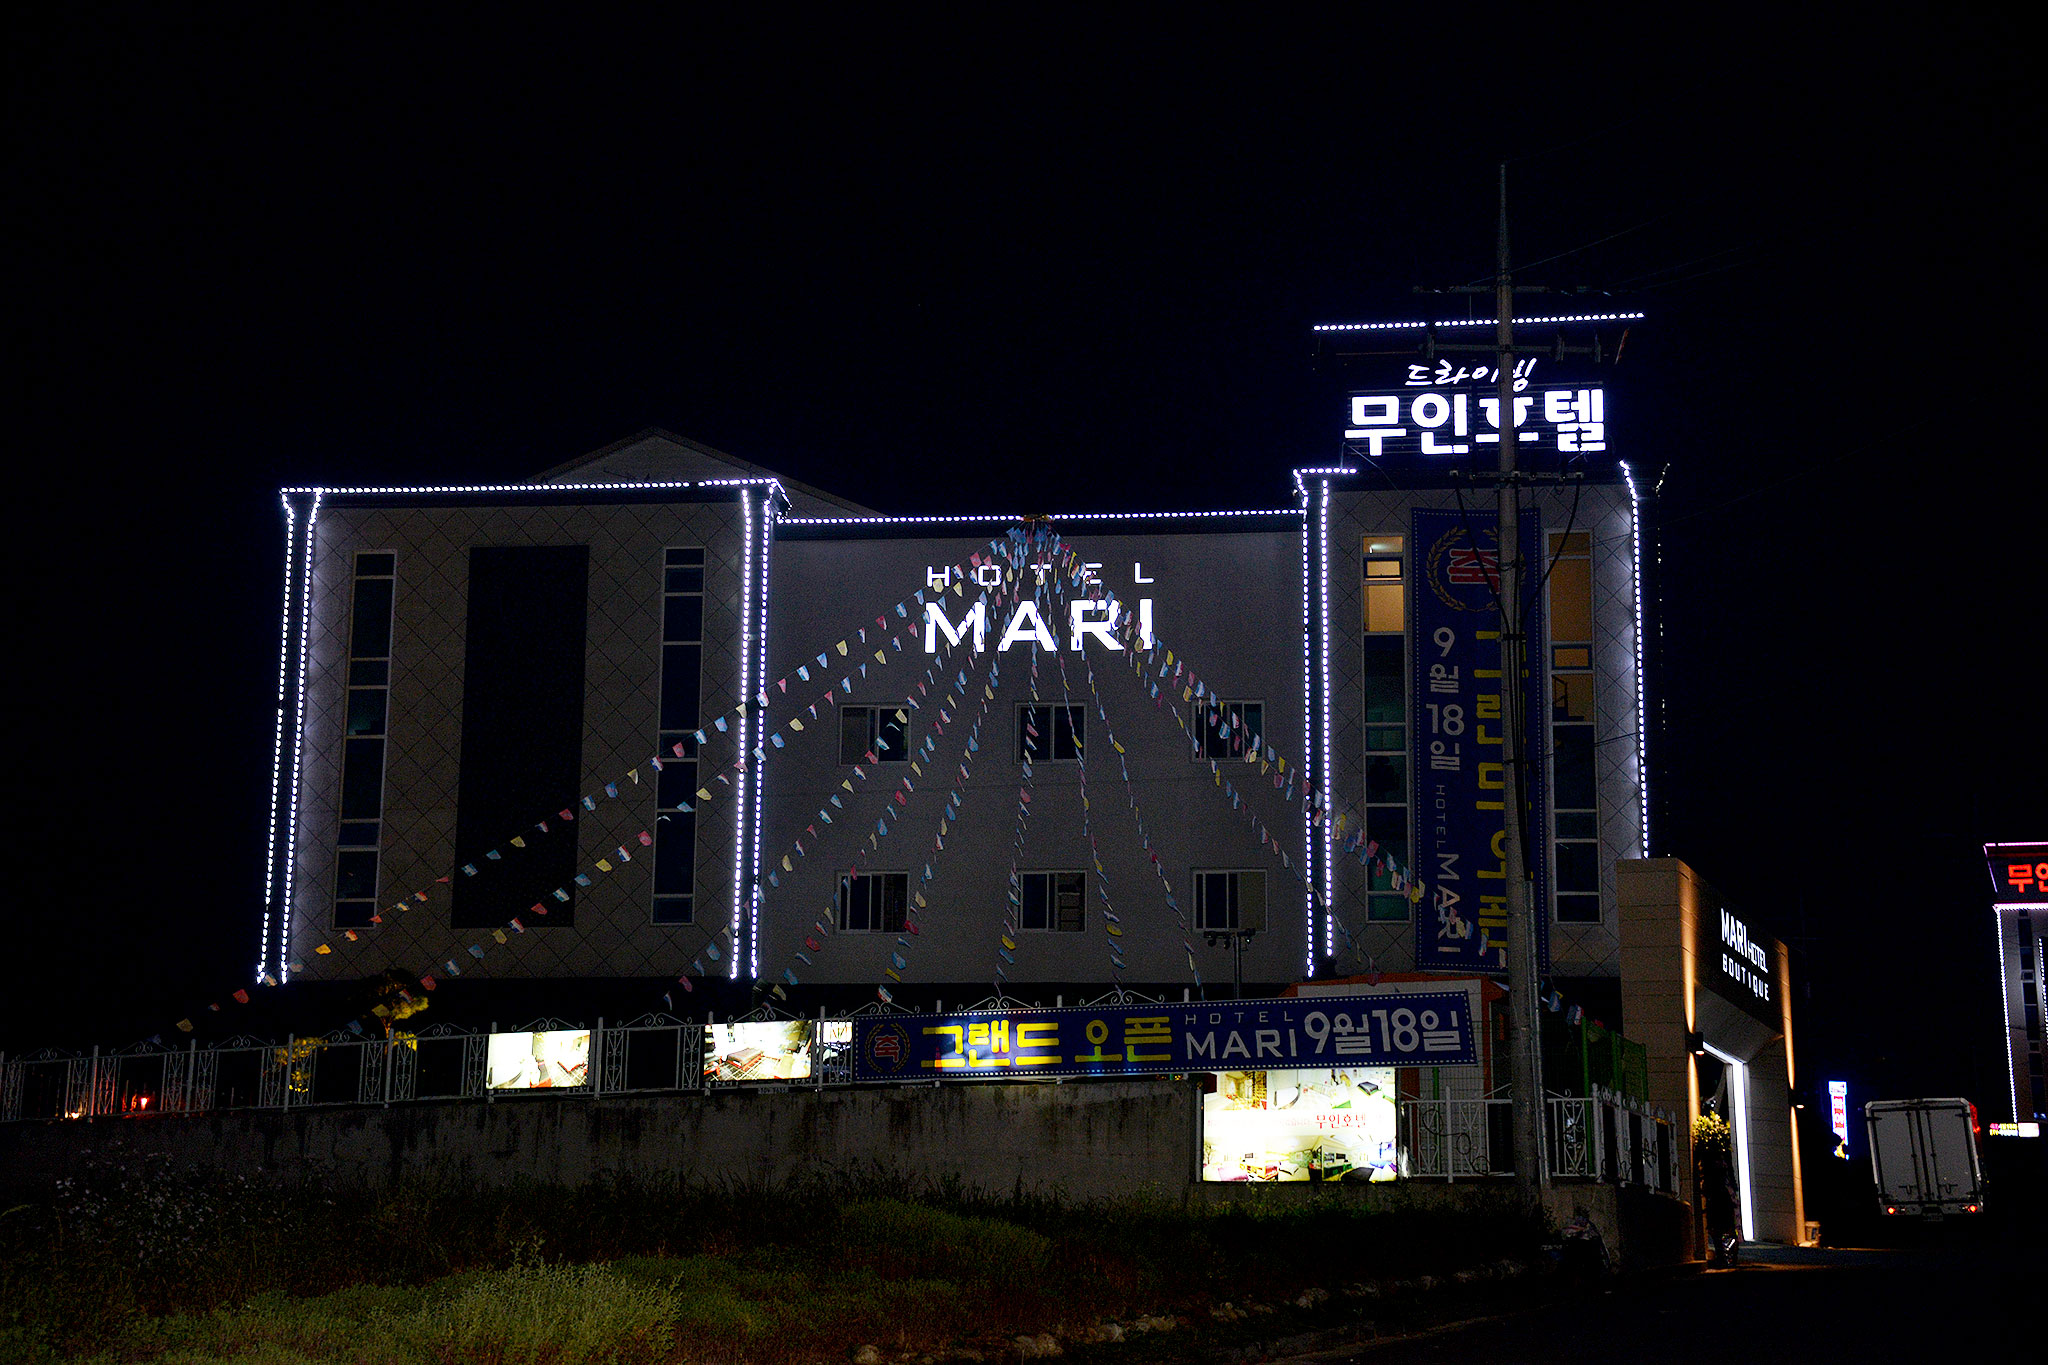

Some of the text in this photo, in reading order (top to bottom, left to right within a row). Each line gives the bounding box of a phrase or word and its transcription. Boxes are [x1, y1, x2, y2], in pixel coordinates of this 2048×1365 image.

[1345, 389, 1606, 456] 무인호텔
[926, 562, 1155, 587] HOTEL
[925, 599, 1153, 653] MARI
[1435, 785, 1447, 849] HOTEL
[1436, 853, 1461, 953] MARI
[1721, 908, 1748, 958] MARI
[1722, 953, 1770, 1001] BOUTIQUE
[920, 1016, 1173, 1068] 그랜드 오픈
[1185, 1010, 1294, 1025] HOTEL
[1186, 1028, 1298, 1060] MARI
